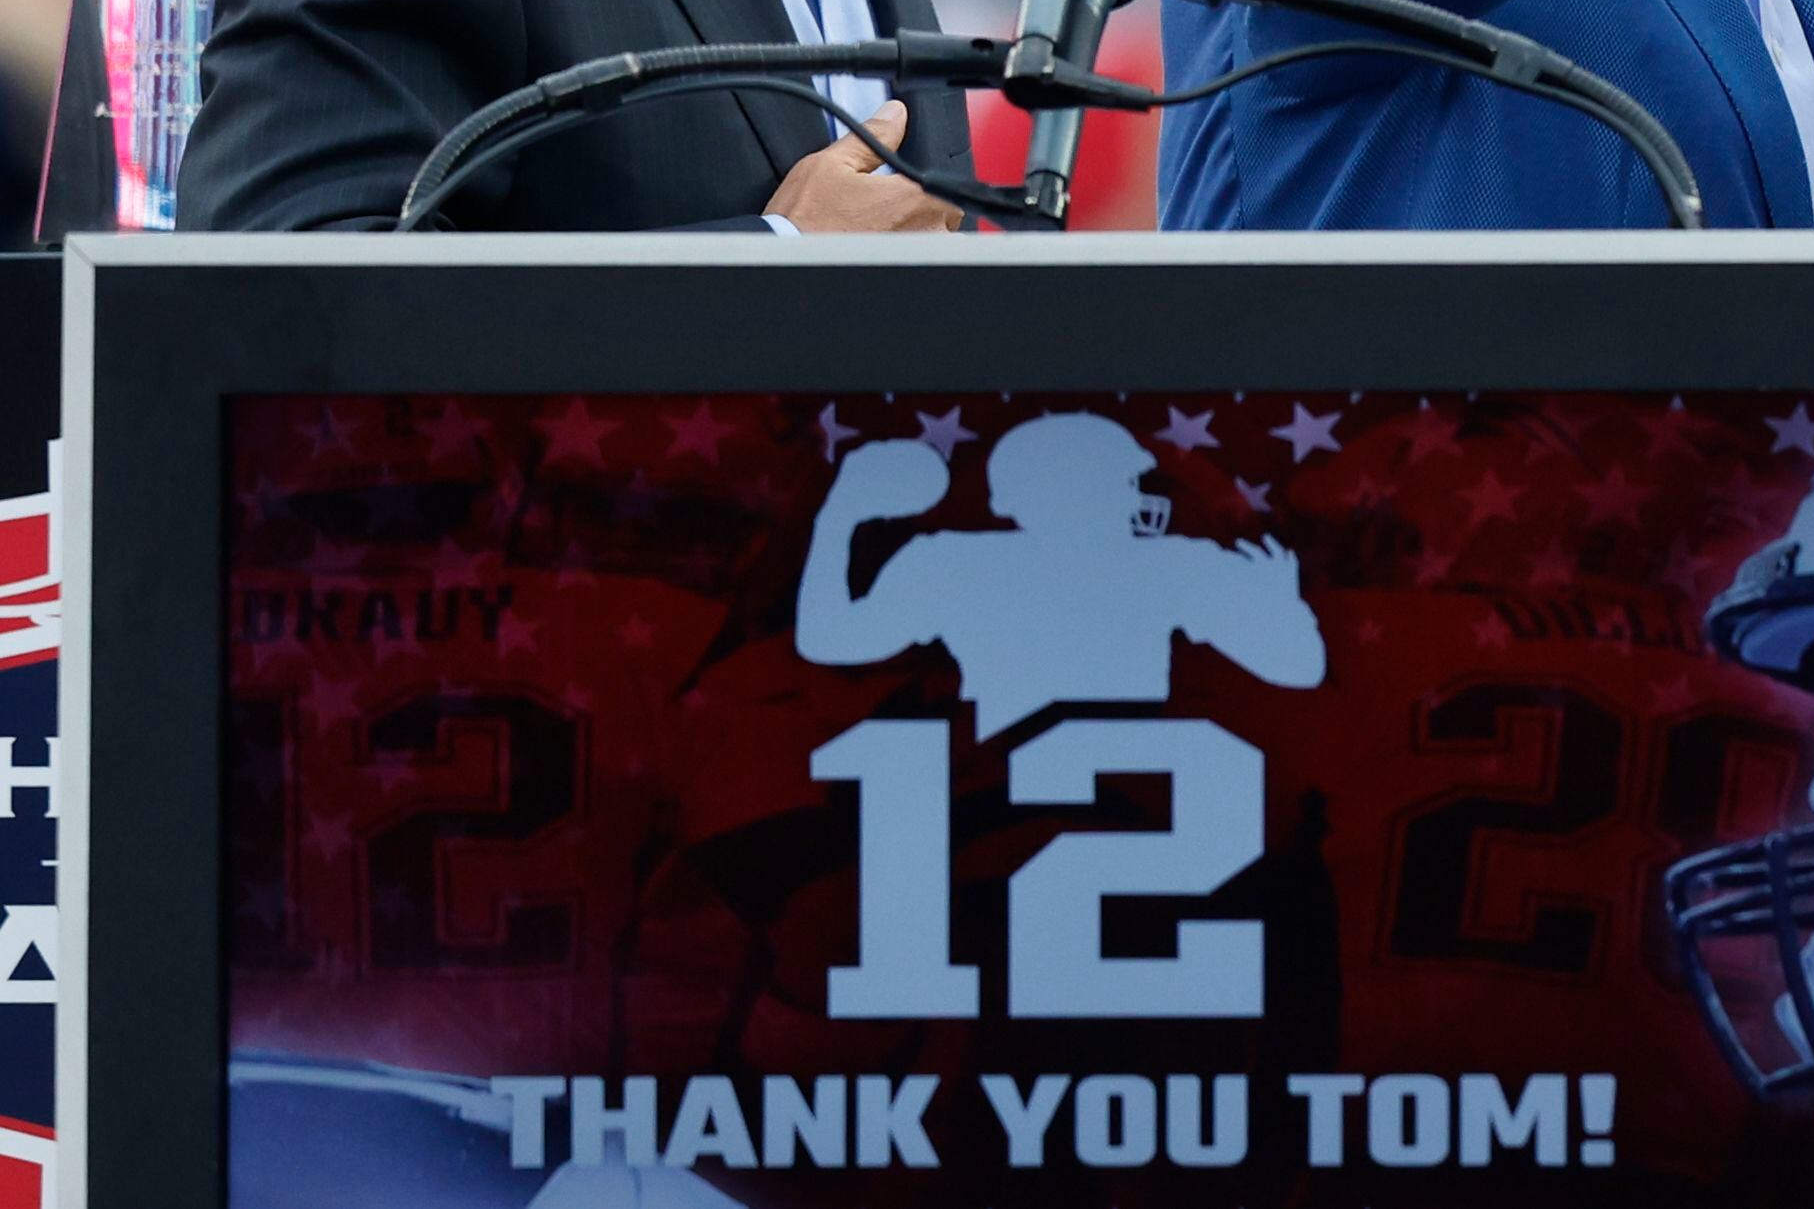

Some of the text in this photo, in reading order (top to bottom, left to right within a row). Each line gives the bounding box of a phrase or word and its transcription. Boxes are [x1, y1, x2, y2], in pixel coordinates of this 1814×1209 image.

[810, 718, 1265, 1019] 12
[489, 1075, 1616, 1169] THANK YOU TOM!
